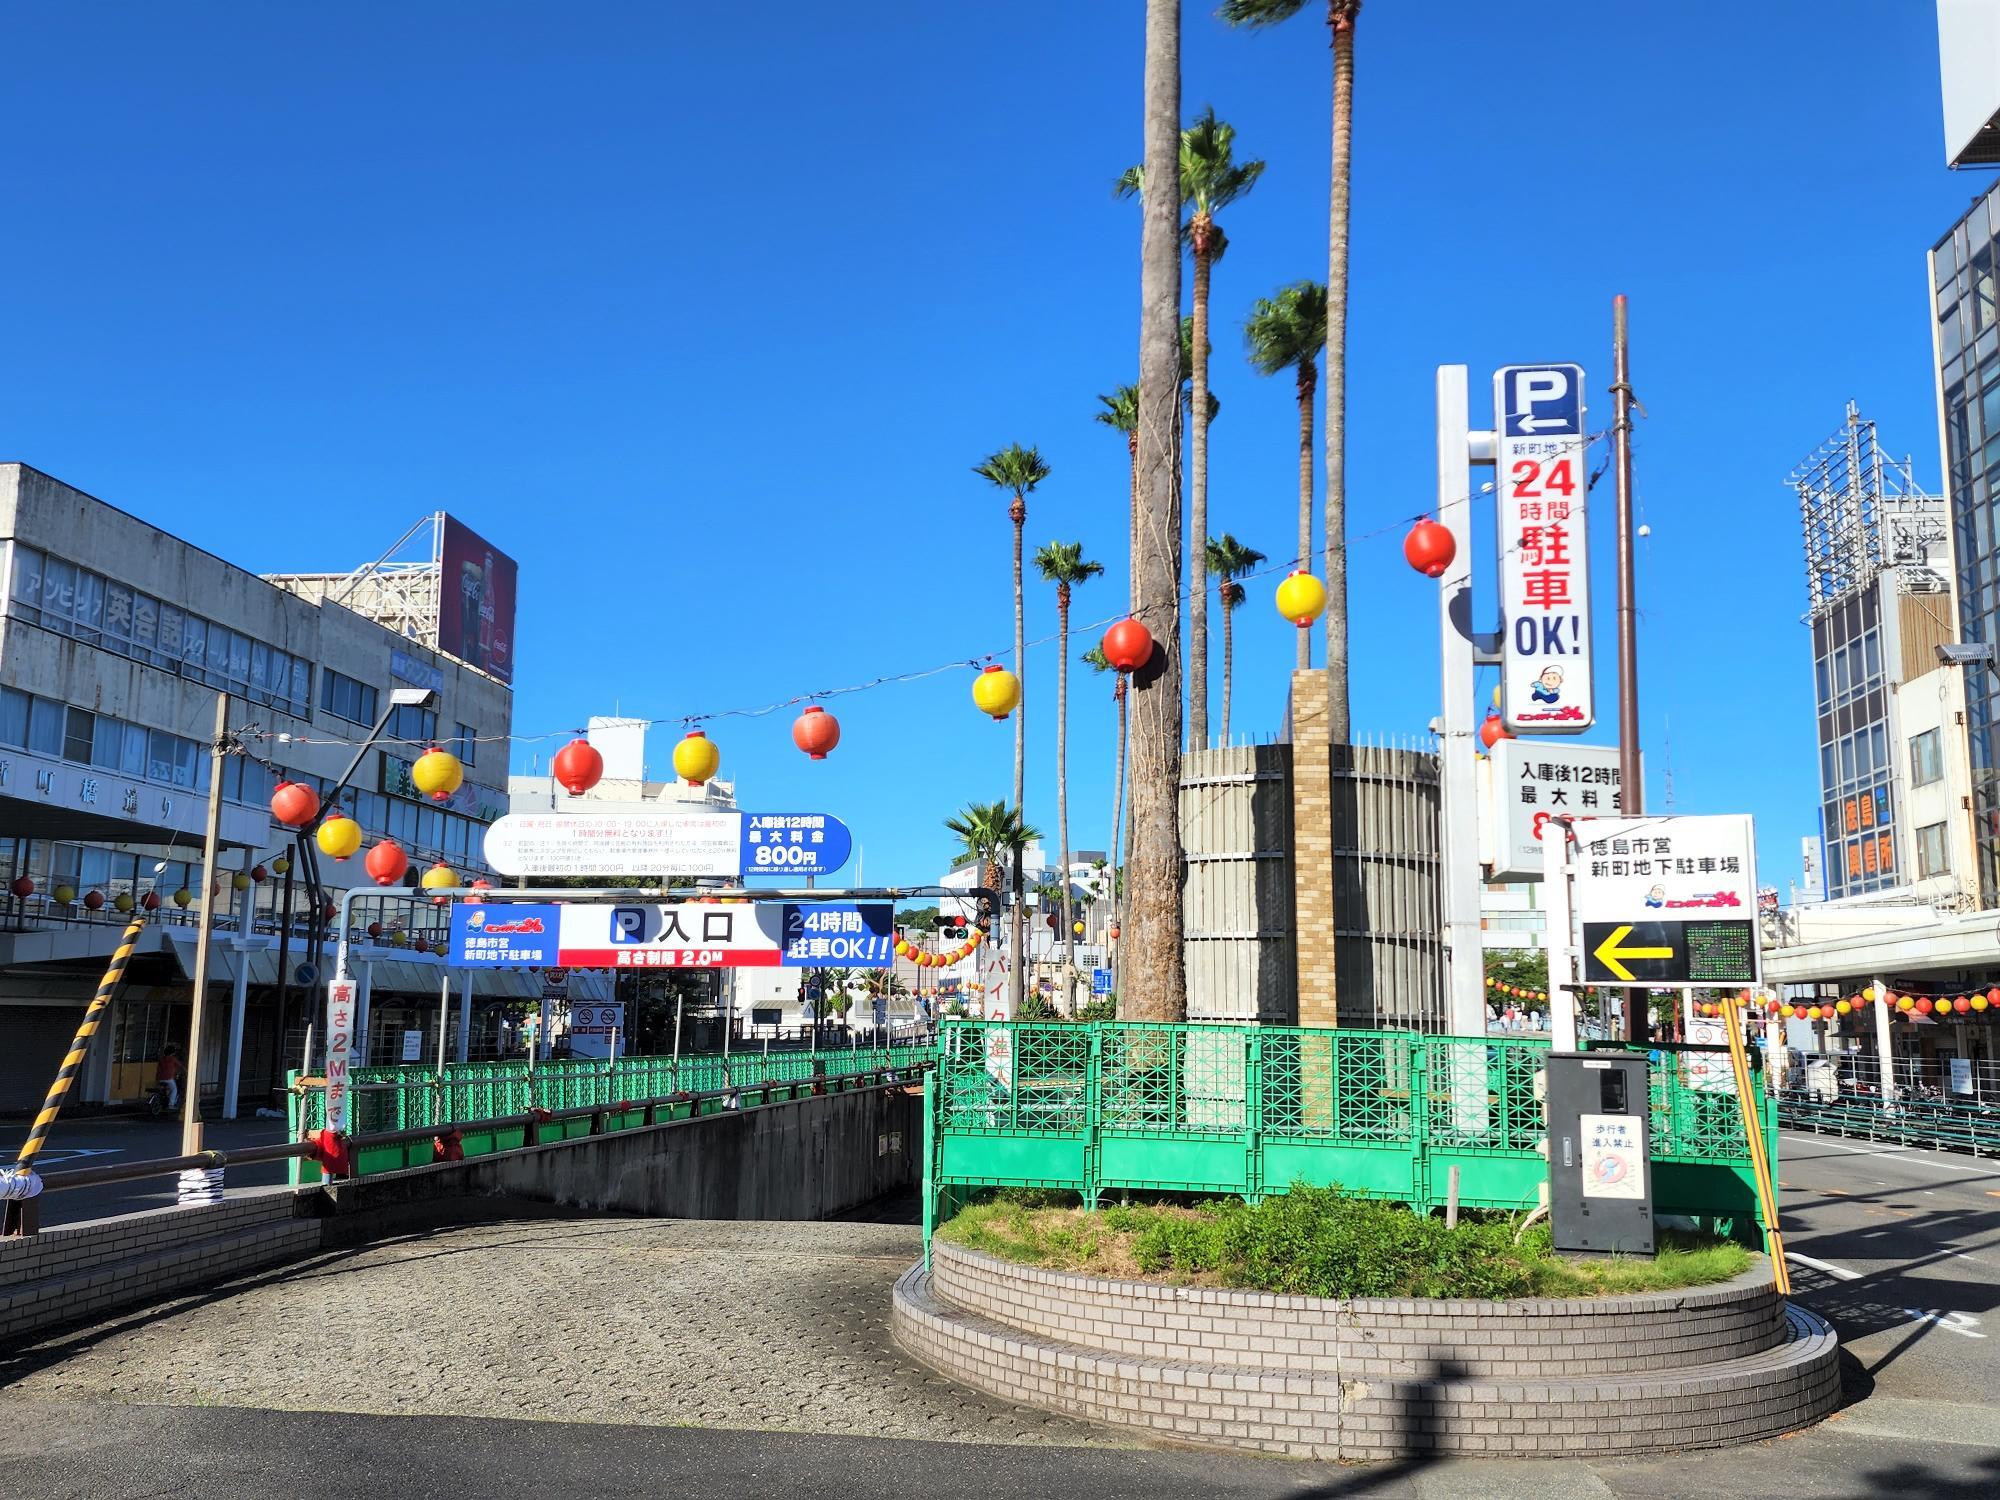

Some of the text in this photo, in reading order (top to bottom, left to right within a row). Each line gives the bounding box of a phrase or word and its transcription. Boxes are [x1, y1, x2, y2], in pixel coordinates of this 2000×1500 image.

[1512, 460, 1575, 498] 24
[1520, 502, 1569, 521] 時間
[1515, 615, 1580, 656] OK!
[749, 816, 825, 829] 入庫後12時間
[749, 830, 824, 843] 最大料金
[755, 845, 817, 865] 800円
[1591, 838, 1671, 856] 徳島市営
[1592, 856, 1740, 877] 新町地下駐車場
[658, 911, 733, 943] 入口
[788, 911, 863, 933] 24時間
[465, 937, 510, 949] 徳島市営
[786, 936, 888, 960] 駐車OK!!
[464, 949, 543, 961] 新町地下駐車場
[617, 950, 676, 965] 高さ制限
[327, 984, 353, 1123] 高さ2Mまで
